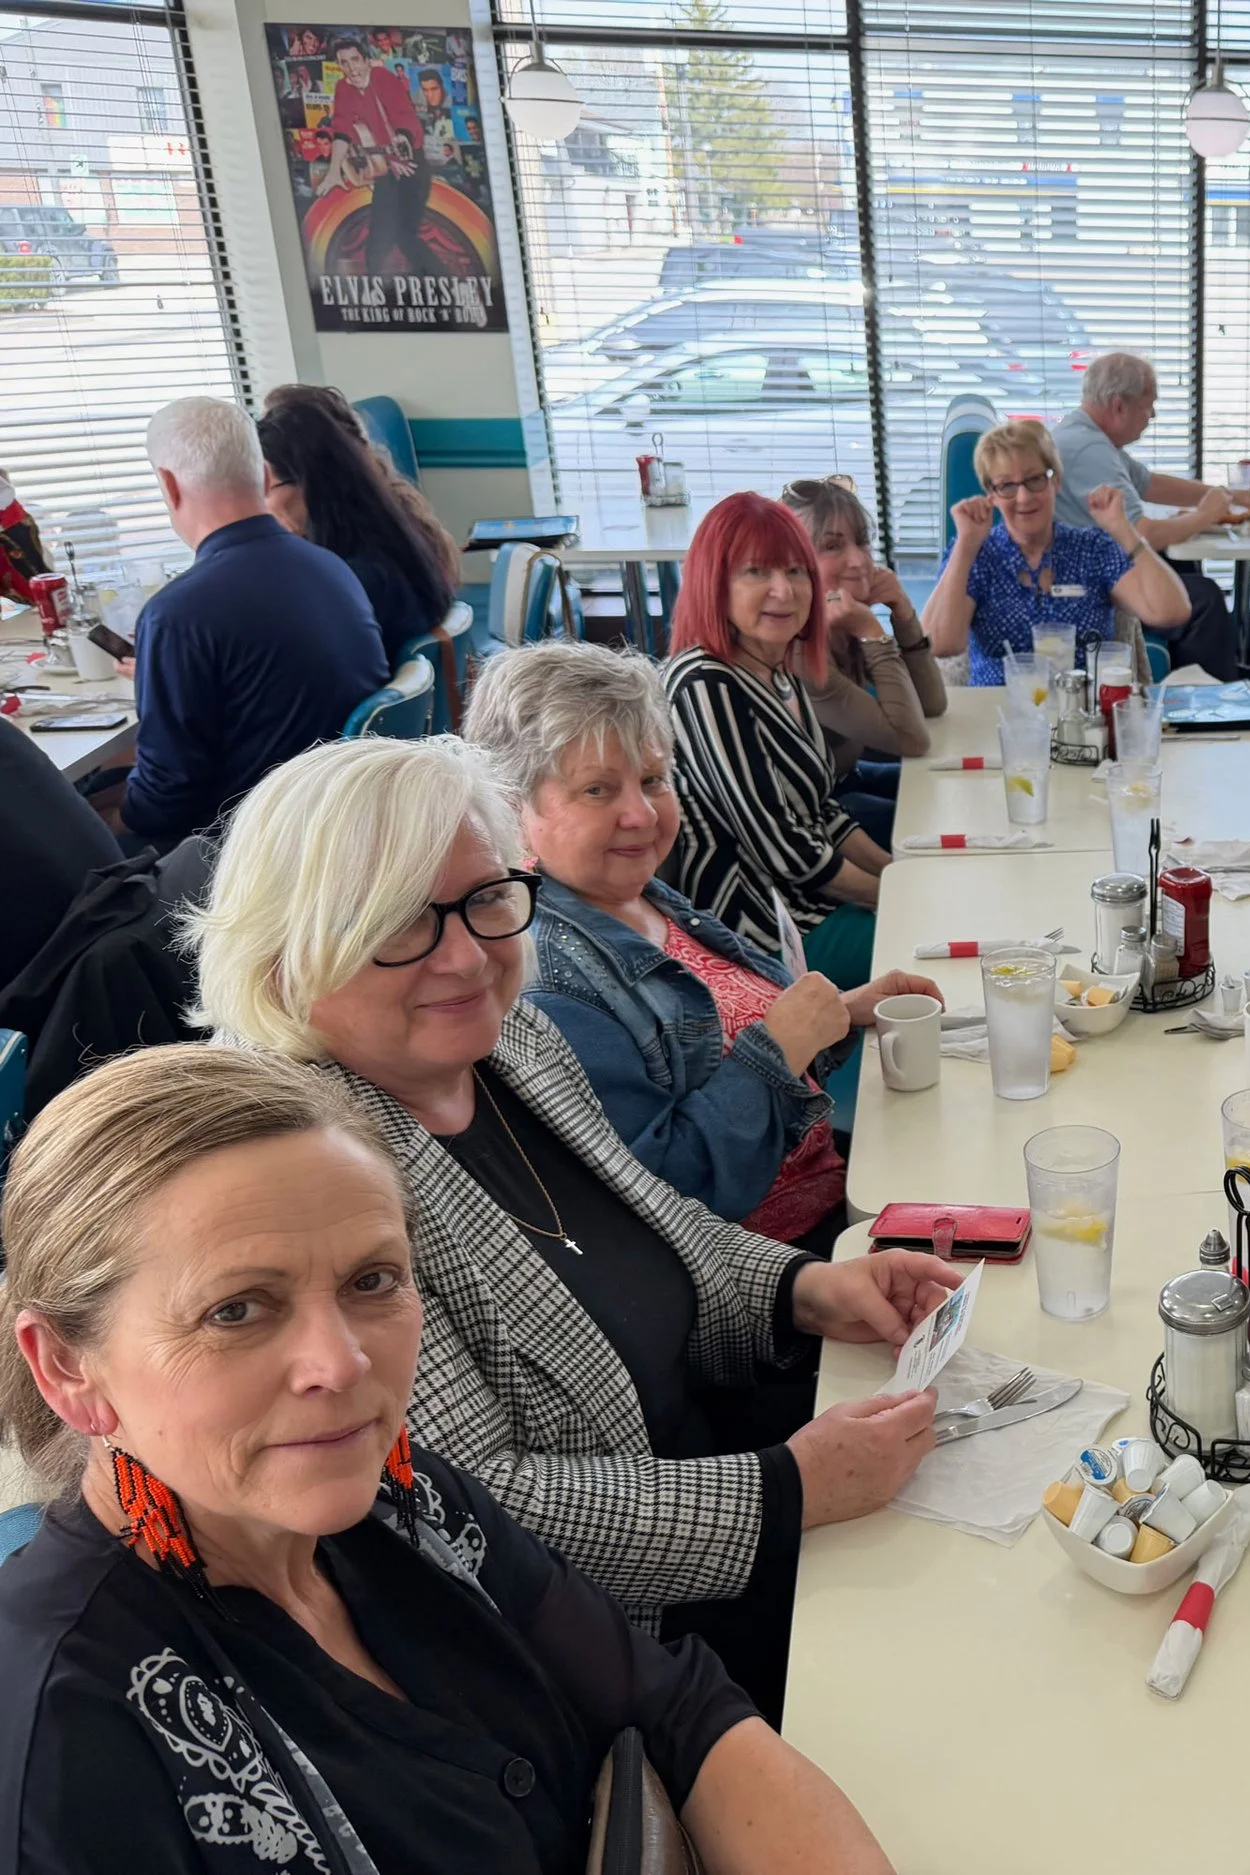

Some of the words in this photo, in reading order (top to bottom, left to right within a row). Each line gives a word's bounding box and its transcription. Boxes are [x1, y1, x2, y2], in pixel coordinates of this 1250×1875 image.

[320, 275, 387, 305] ELVIS
[394, 275, 493, 307] PRESLEY
[341, 307, 360, 321] THE
[361, 307, 391, 322] KING
[393, 309, 405, 321] OF
[408, 307, 435, 322] ROCK
